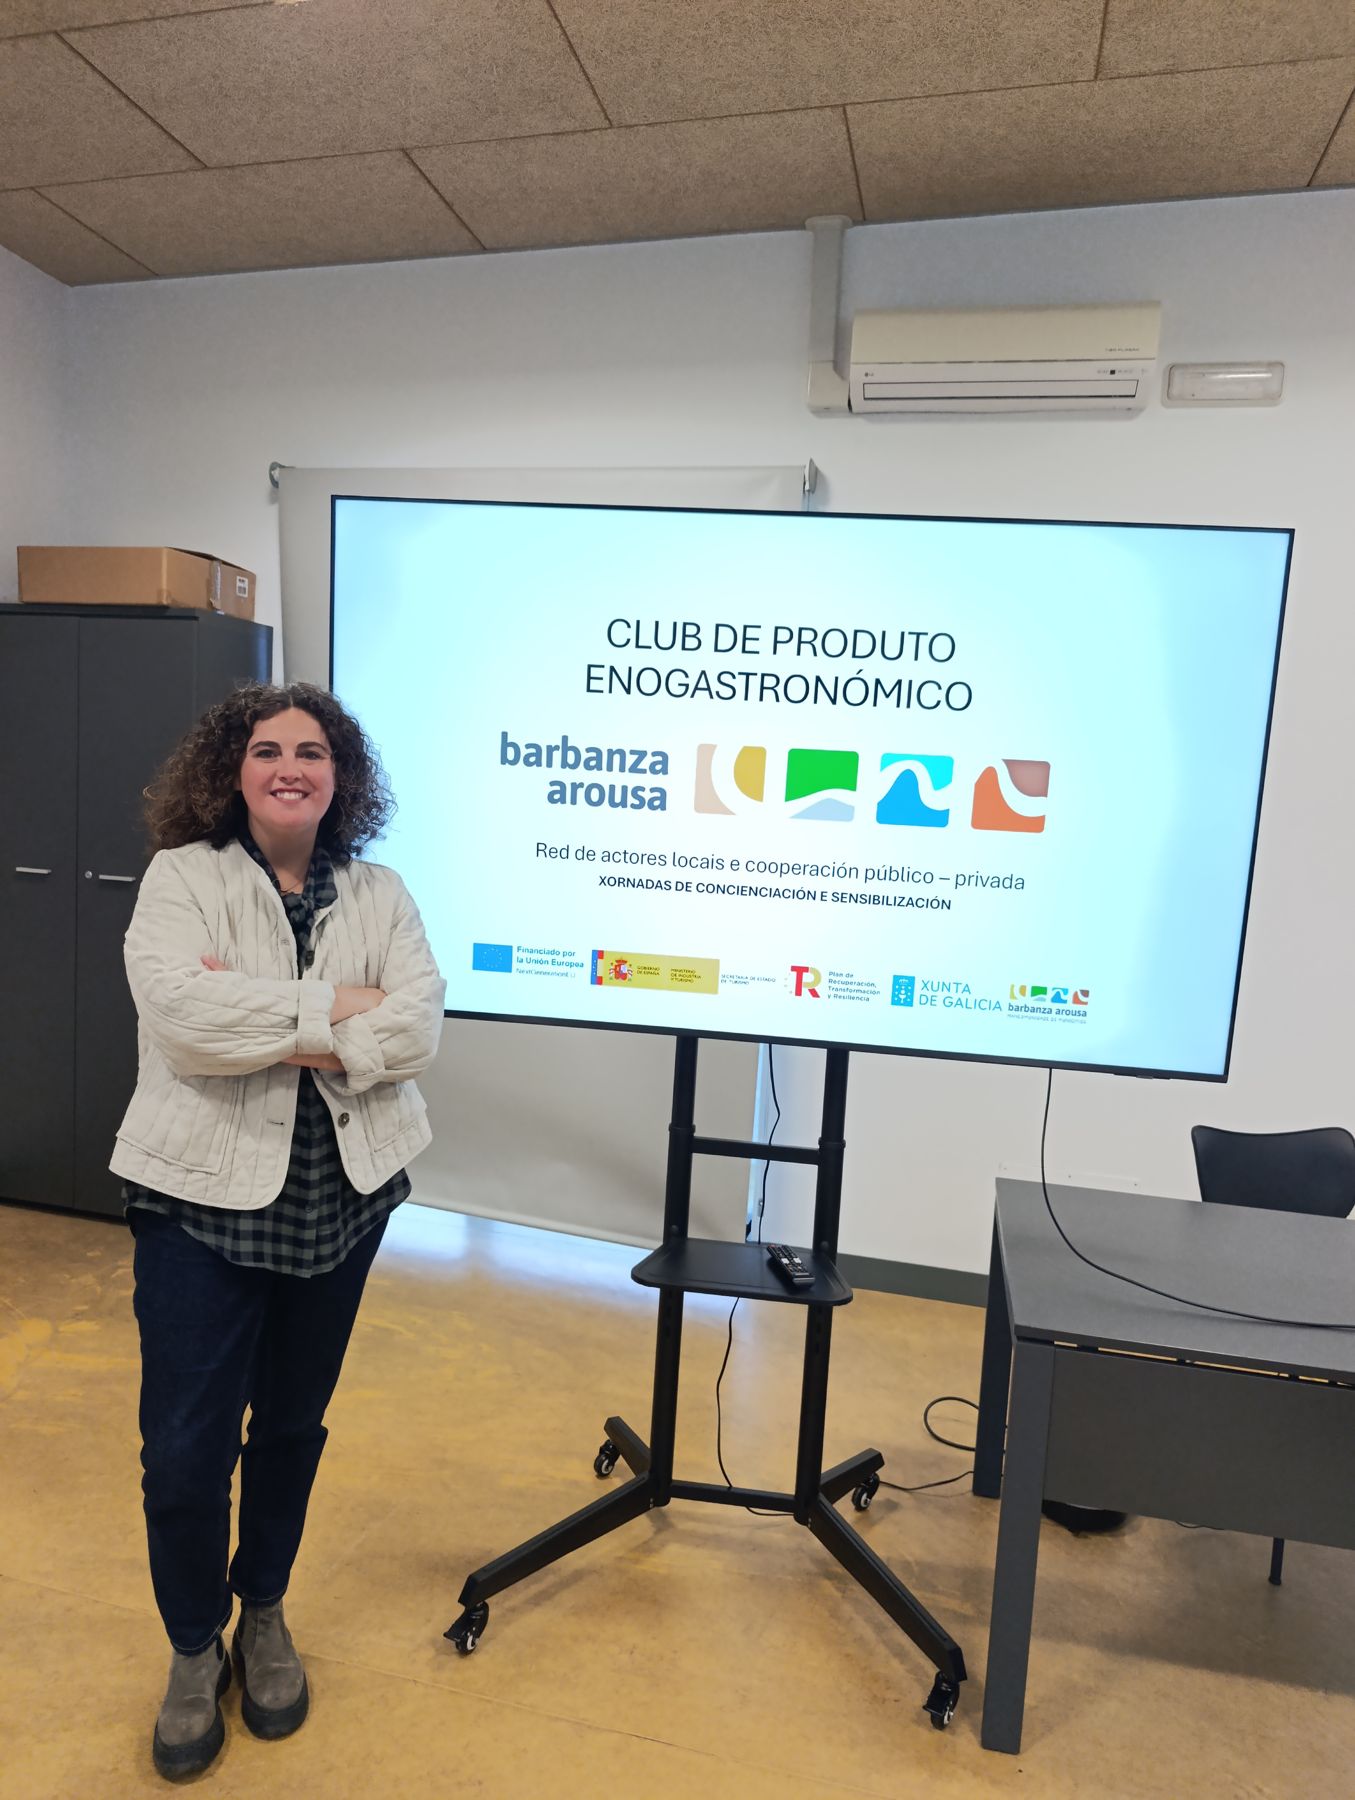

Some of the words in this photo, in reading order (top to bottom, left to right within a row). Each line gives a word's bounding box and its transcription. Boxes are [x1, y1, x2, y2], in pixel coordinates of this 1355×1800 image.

[607, 619, 701, 651] CLUB
[714, 624, 761, 654] DE
[773, 626, 955, 662] PRODUTO
[586, 664, 972, 711] ENOGASTRONÓMICO
[500, 731, 668, 775] barbanza
[547, 780, 666, 811] arousa
[537, 843, 569, 859] Red
[575, 846, 595, 861] de
[601, 850, 666, 866] actores
[673, 852, 724, 870] locais
[730, 860, 739, 871] e
[746, 861, 858, 879] cooperación
[865, 866, 933, 883] público
[955, 874, 1024, 890] privada
[599, 876, 671, 890] XORNADAS
[675, 881, 692, 892] DE
[696, 883, 816, 900] CONCIENCIACIÓN
[821, 891, 827, 901] E
[831, 892, 951, 910] SENSIBILIZACIÓN
[517, 946, 560, 956] Financiado
[526, 957, 548, 965] Unión
[552, 959, 584, 968] Europea
[921, 979, 971, 995] XUNTA
[919, 994, 938, 1007] DE
[943, 996, 1002, 1012] GALICIA
[1008, 1003, 1052, 1014] barbanza
[1056, 1008, 1087, 1017] arousa
